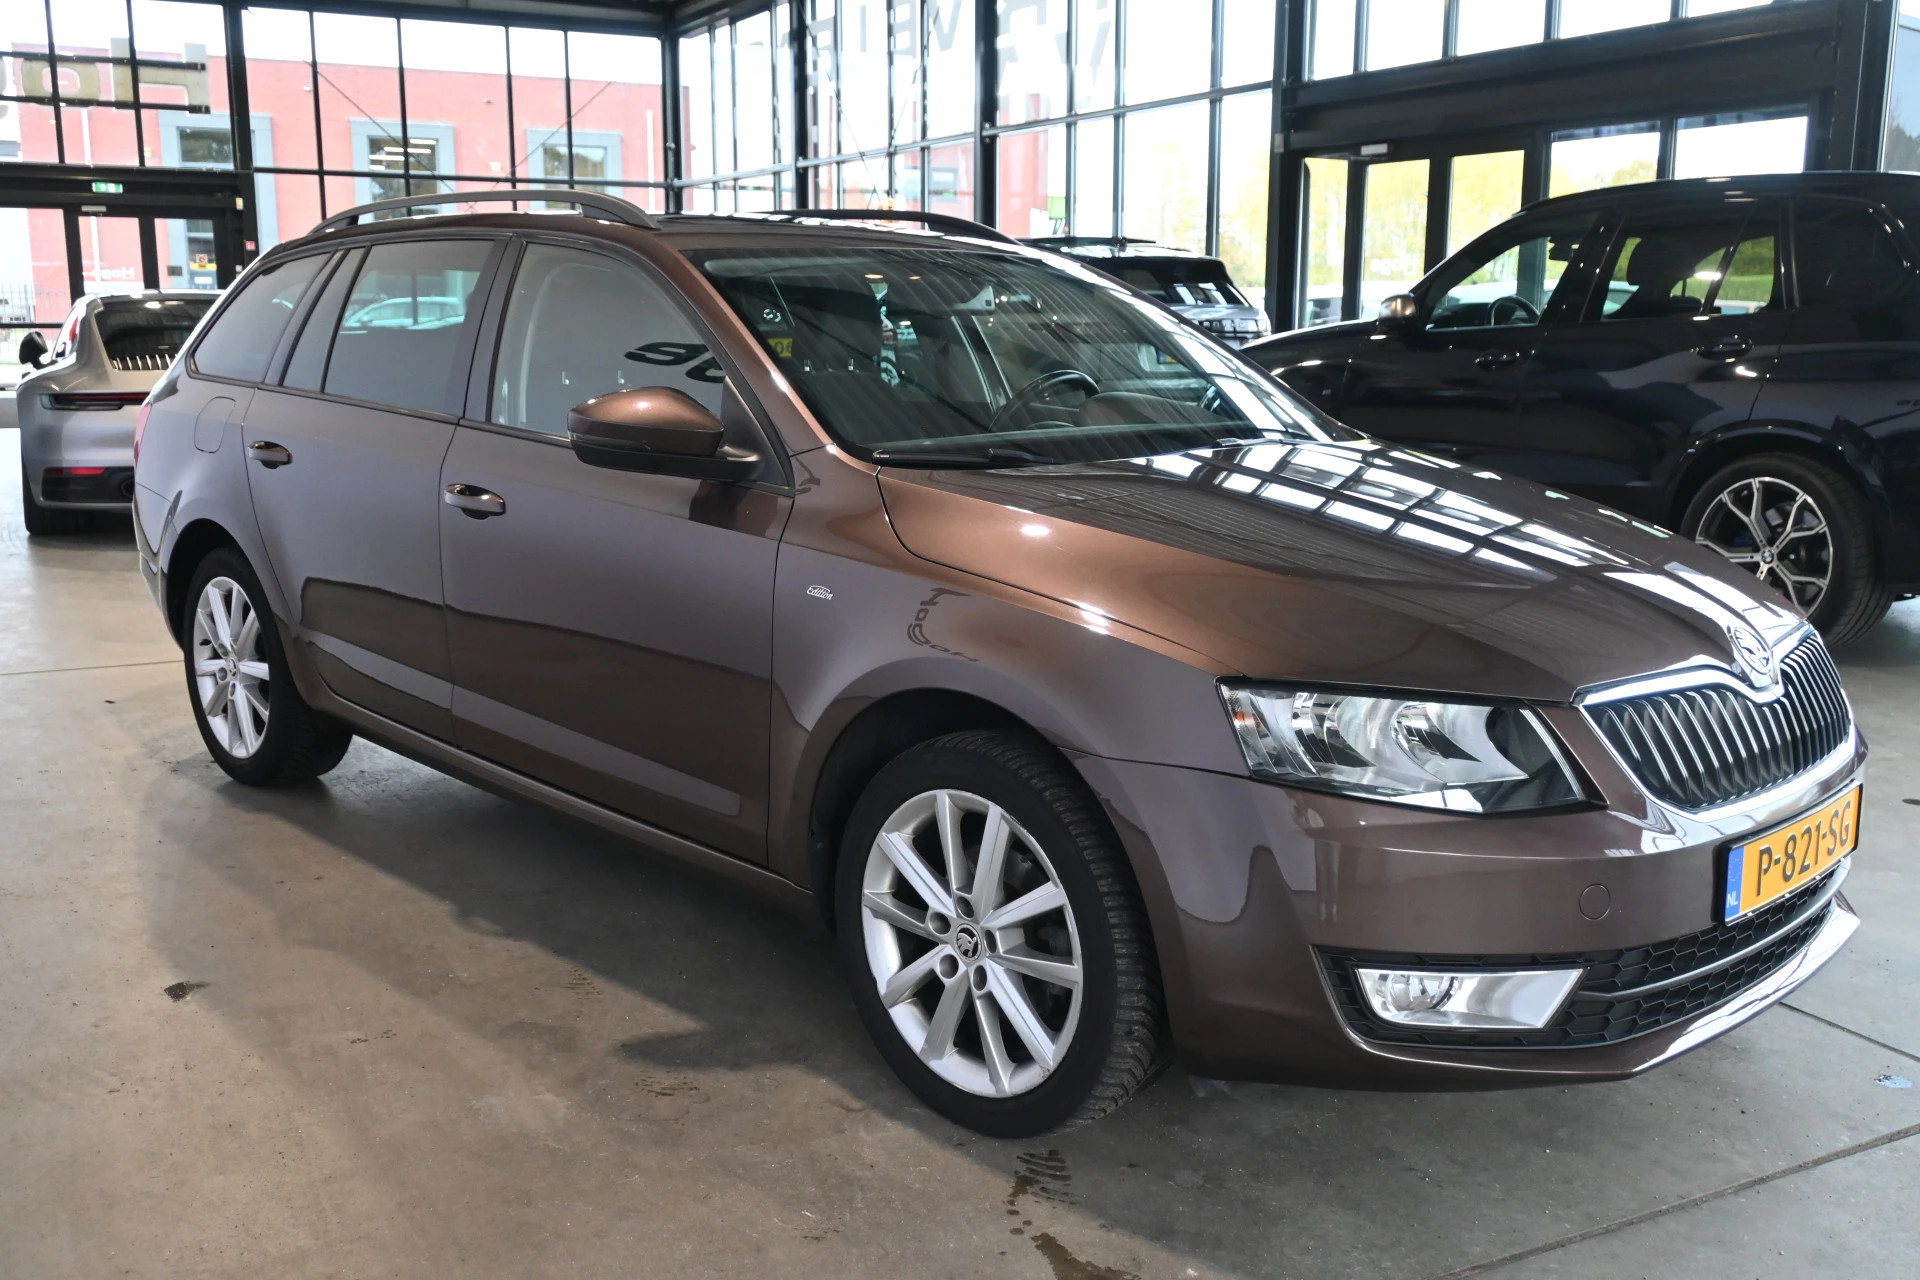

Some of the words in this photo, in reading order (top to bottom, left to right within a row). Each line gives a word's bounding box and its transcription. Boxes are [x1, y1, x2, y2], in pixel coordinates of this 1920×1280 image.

[806, 585, 833, 600] Edition
[1756, 800, 1851, 896] P-821-SG
[1726, 891, 1739, 908] NL
